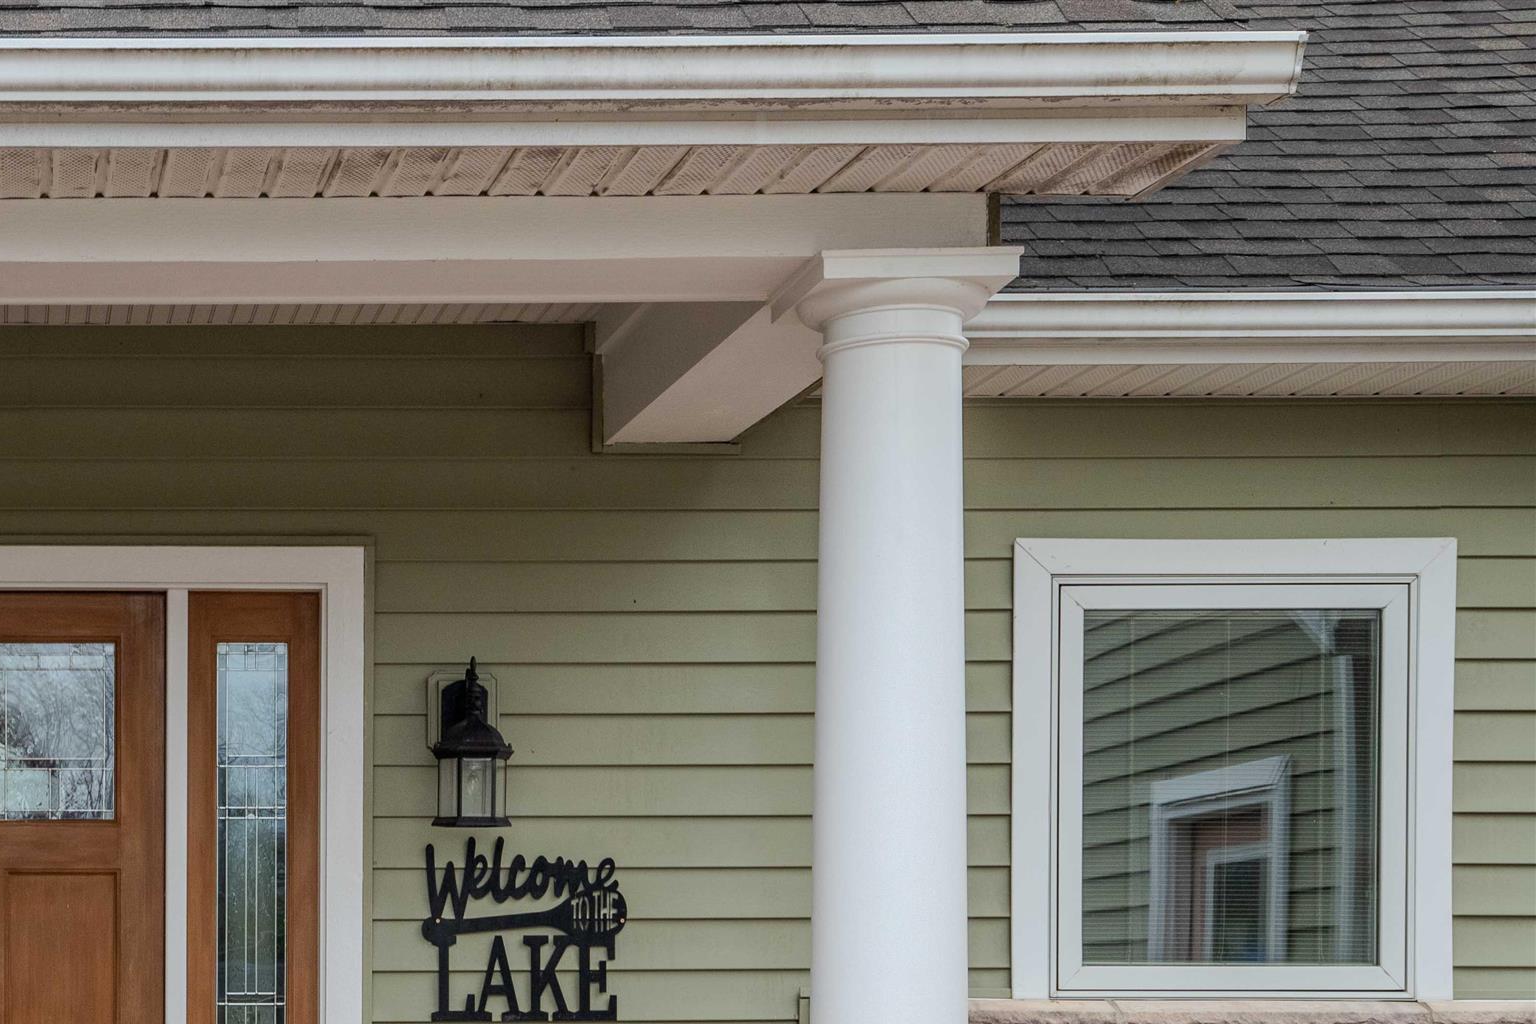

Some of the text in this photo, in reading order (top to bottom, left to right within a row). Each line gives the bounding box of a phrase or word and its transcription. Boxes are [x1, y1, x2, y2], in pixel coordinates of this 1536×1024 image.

[425, 836, 619, 919] Welcome
[571, 890, 619, 933] TO THE
[431, 935, 617, 1021] LAKE
